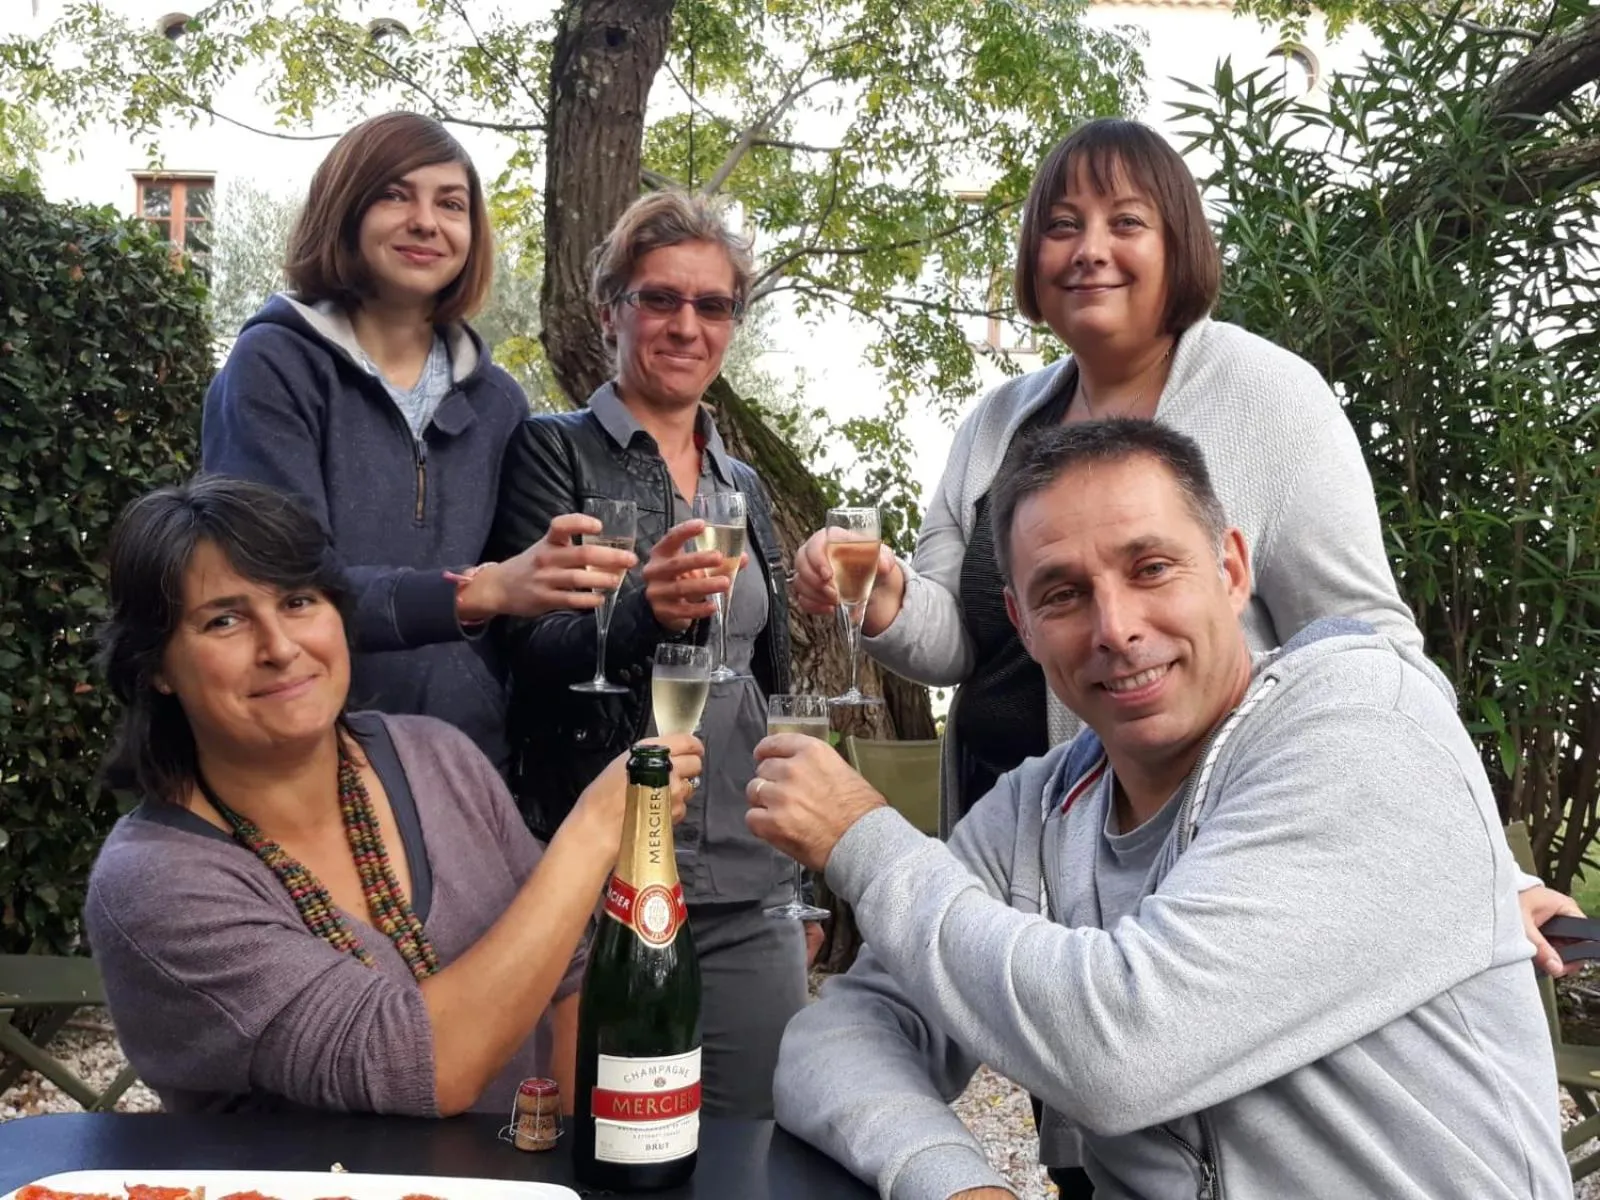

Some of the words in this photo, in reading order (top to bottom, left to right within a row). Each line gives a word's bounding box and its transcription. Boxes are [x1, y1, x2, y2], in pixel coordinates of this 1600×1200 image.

[649, 792, 661, 864] MERCIER
[623, 1065, 691, 1083] CHAMPAGNE
[612, 1094, 693, 1115] MERCIER
[645, 1142, 670, 1151] BRUT
